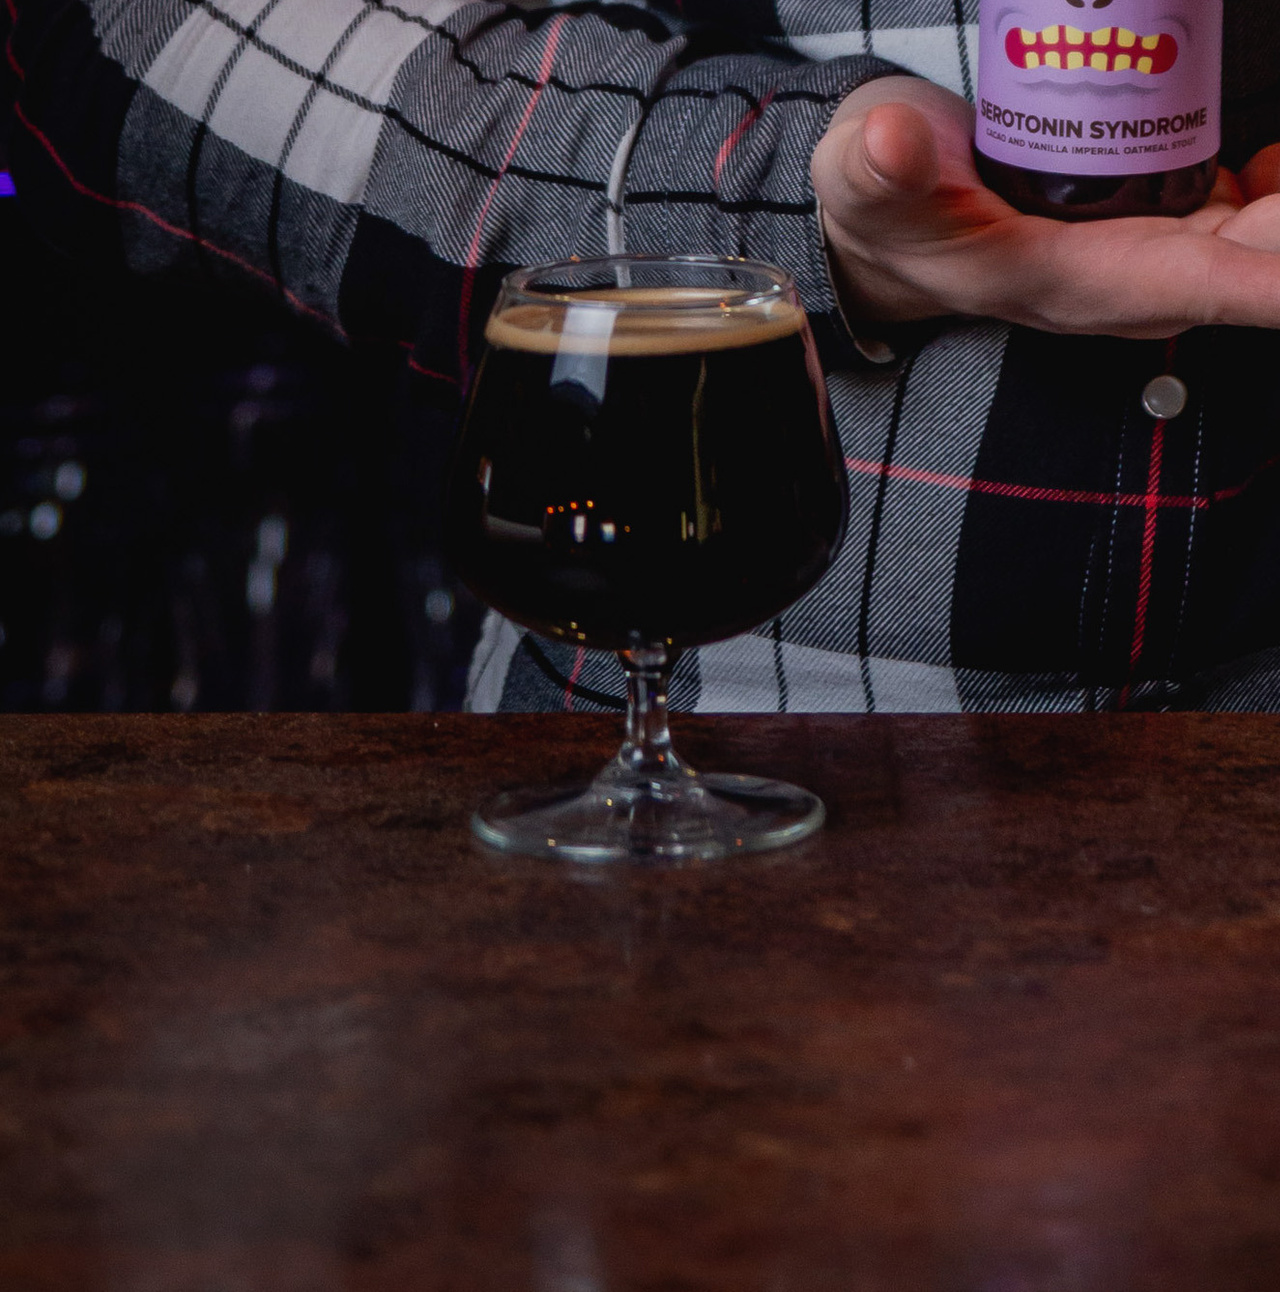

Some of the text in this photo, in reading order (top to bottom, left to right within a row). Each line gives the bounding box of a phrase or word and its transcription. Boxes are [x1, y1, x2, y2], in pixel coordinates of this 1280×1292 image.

[980, 98, 1208, 140] SEROTONIN SYNDROME
[986, 128, 1197, 156] CACAO AND VANILLA IMPERIAL OATMEAL STOUT
